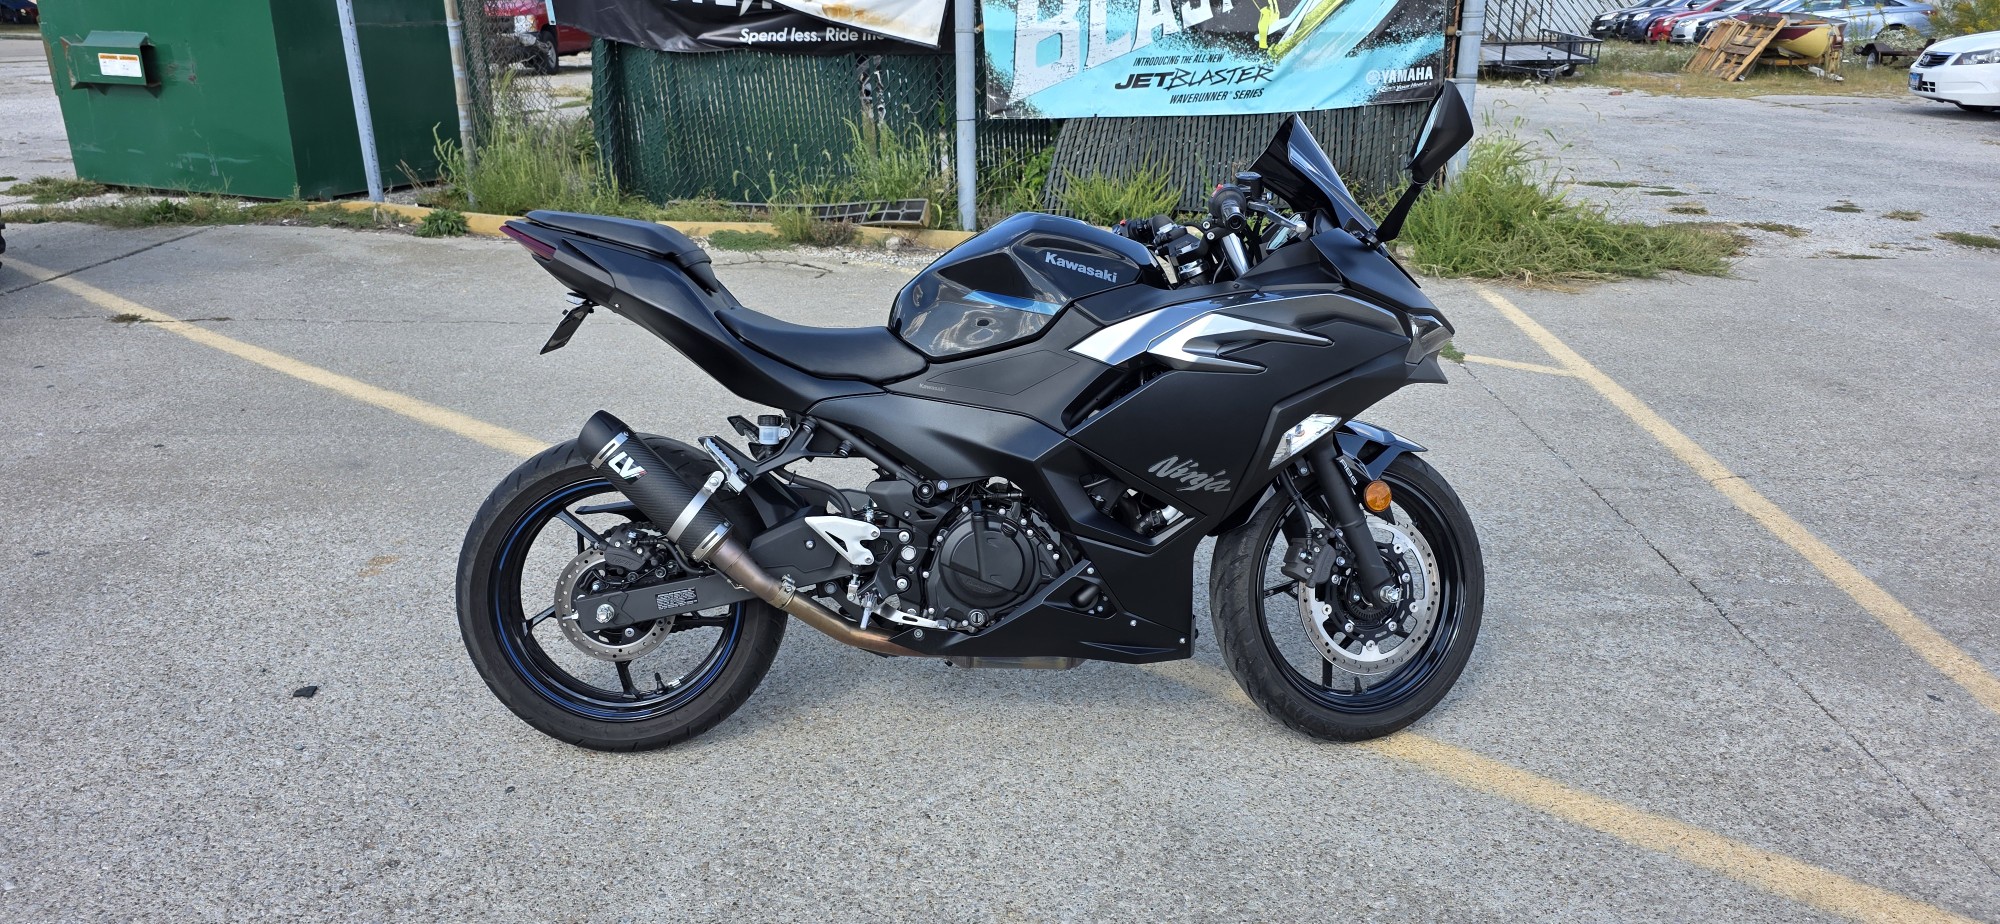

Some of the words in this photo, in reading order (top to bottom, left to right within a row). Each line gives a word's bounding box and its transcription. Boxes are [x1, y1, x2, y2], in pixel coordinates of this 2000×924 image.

[739, 27, 788, 45] Spend
[790, 27, 821, 42] less.
[825, 27, 859, 42] Ride
[1133, 55, 1179, 66] INTRODUCING
[1181, 56, 1193, 65] THE
[1192, 53, 1225, 63] ALL-NEW
[1381, 66, 1434, 83] YAMAHA
[1232, 88, 1265, 100] SERIES
[1044, 251, 1118, 284] Kawasaki
[1147, 455, 1231, 493] Ninja
